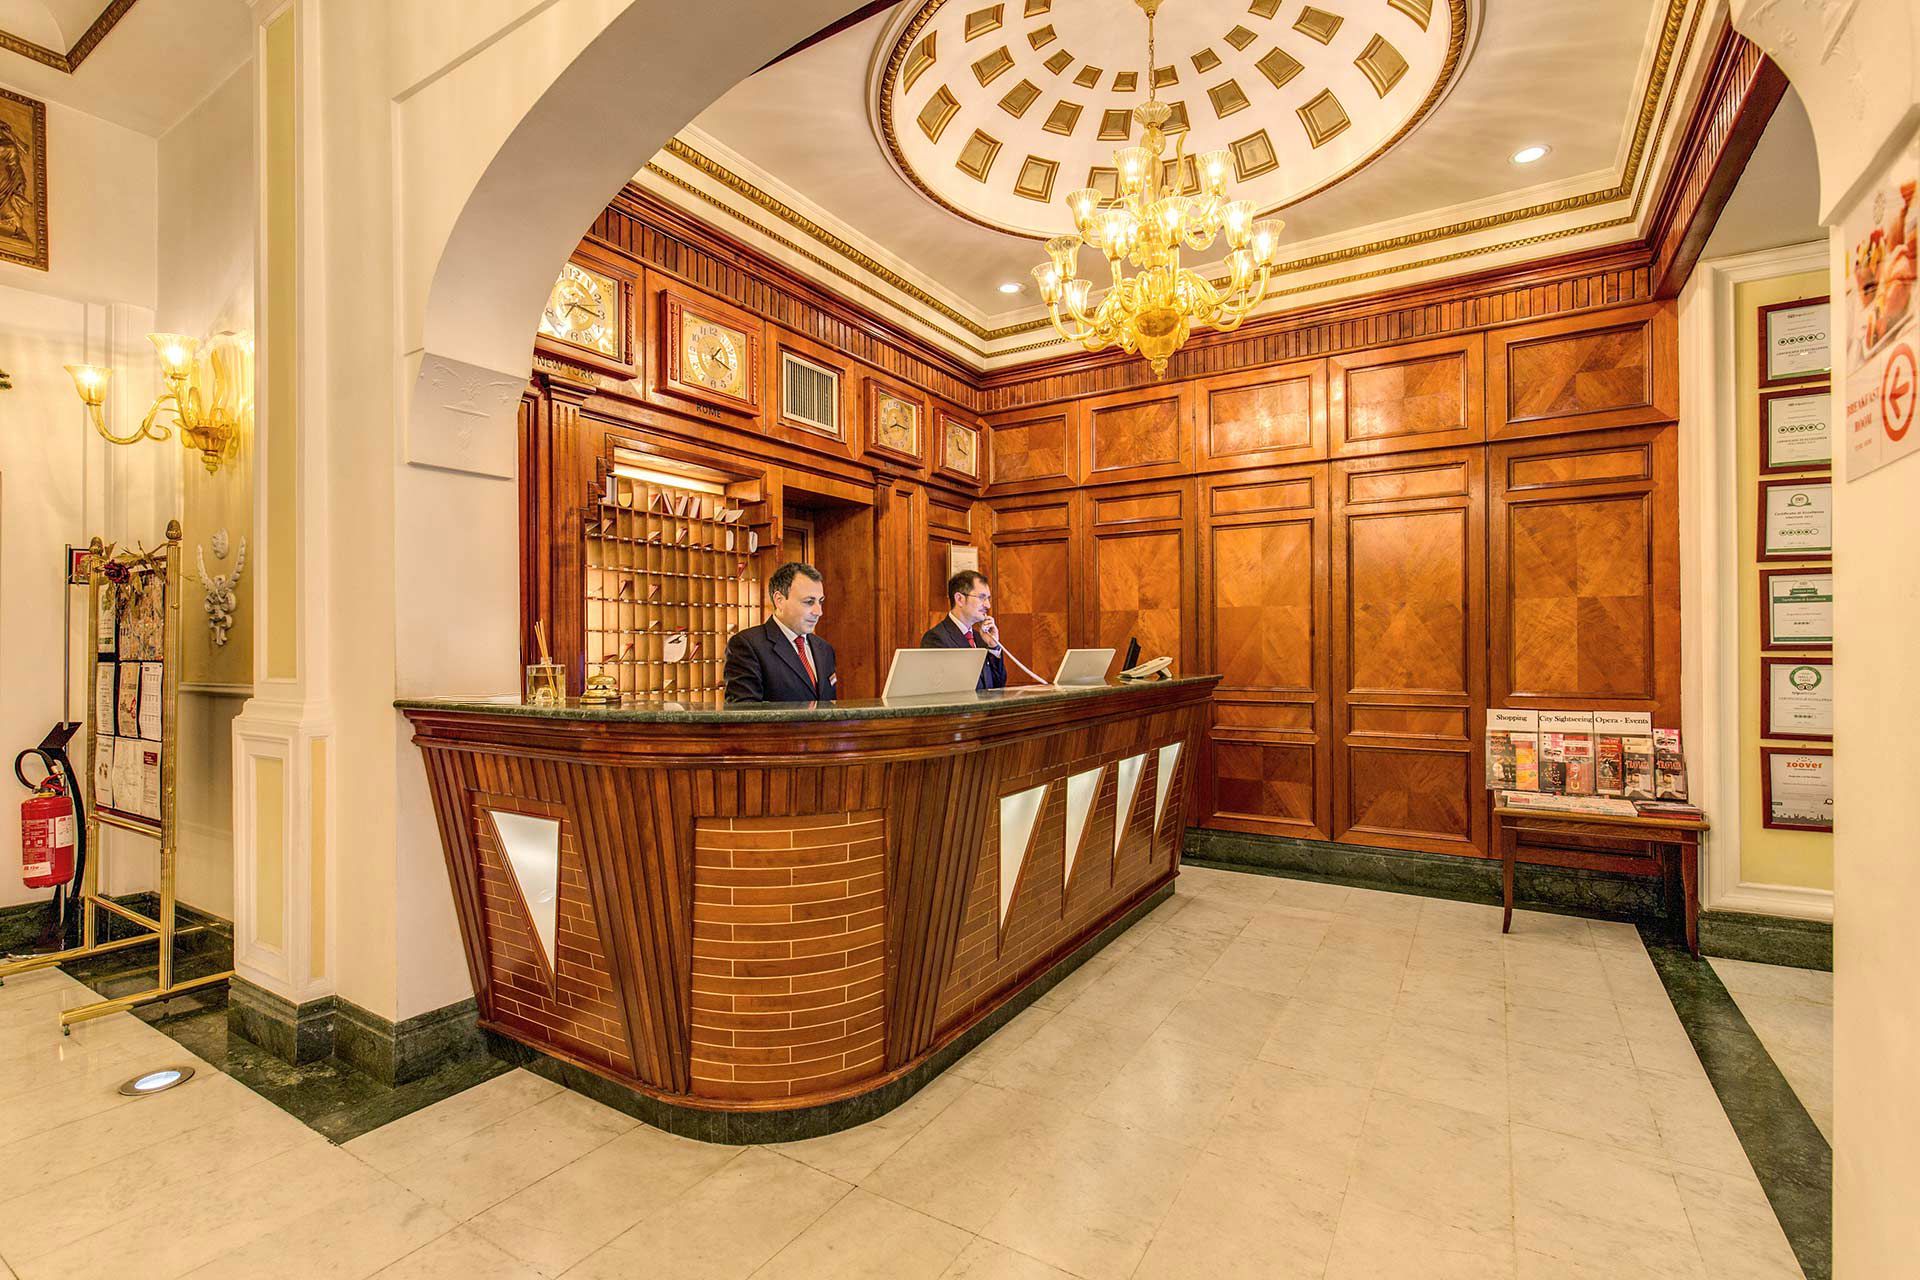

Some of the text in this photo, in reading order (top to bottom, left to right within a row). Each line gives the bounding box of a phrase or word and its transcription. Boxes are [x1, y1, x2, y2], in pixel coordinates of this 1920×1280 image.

[569, 268, 581, 281] 12
[594, 293, 603, 305] 2
[570, 331, 580, 342] 6
[537, 357, 595, 381] NEW YORK
[696, 404, 721, 419] ROME
[1495, 714, 1528, 722] Shopping
[1539, 715, 1593, 724] City Sightseeing
[1595, 716, 1619, 725] Opera
[1624, 717, 1649, 725] Events
[1785, 761, 1824, 769] zoover
